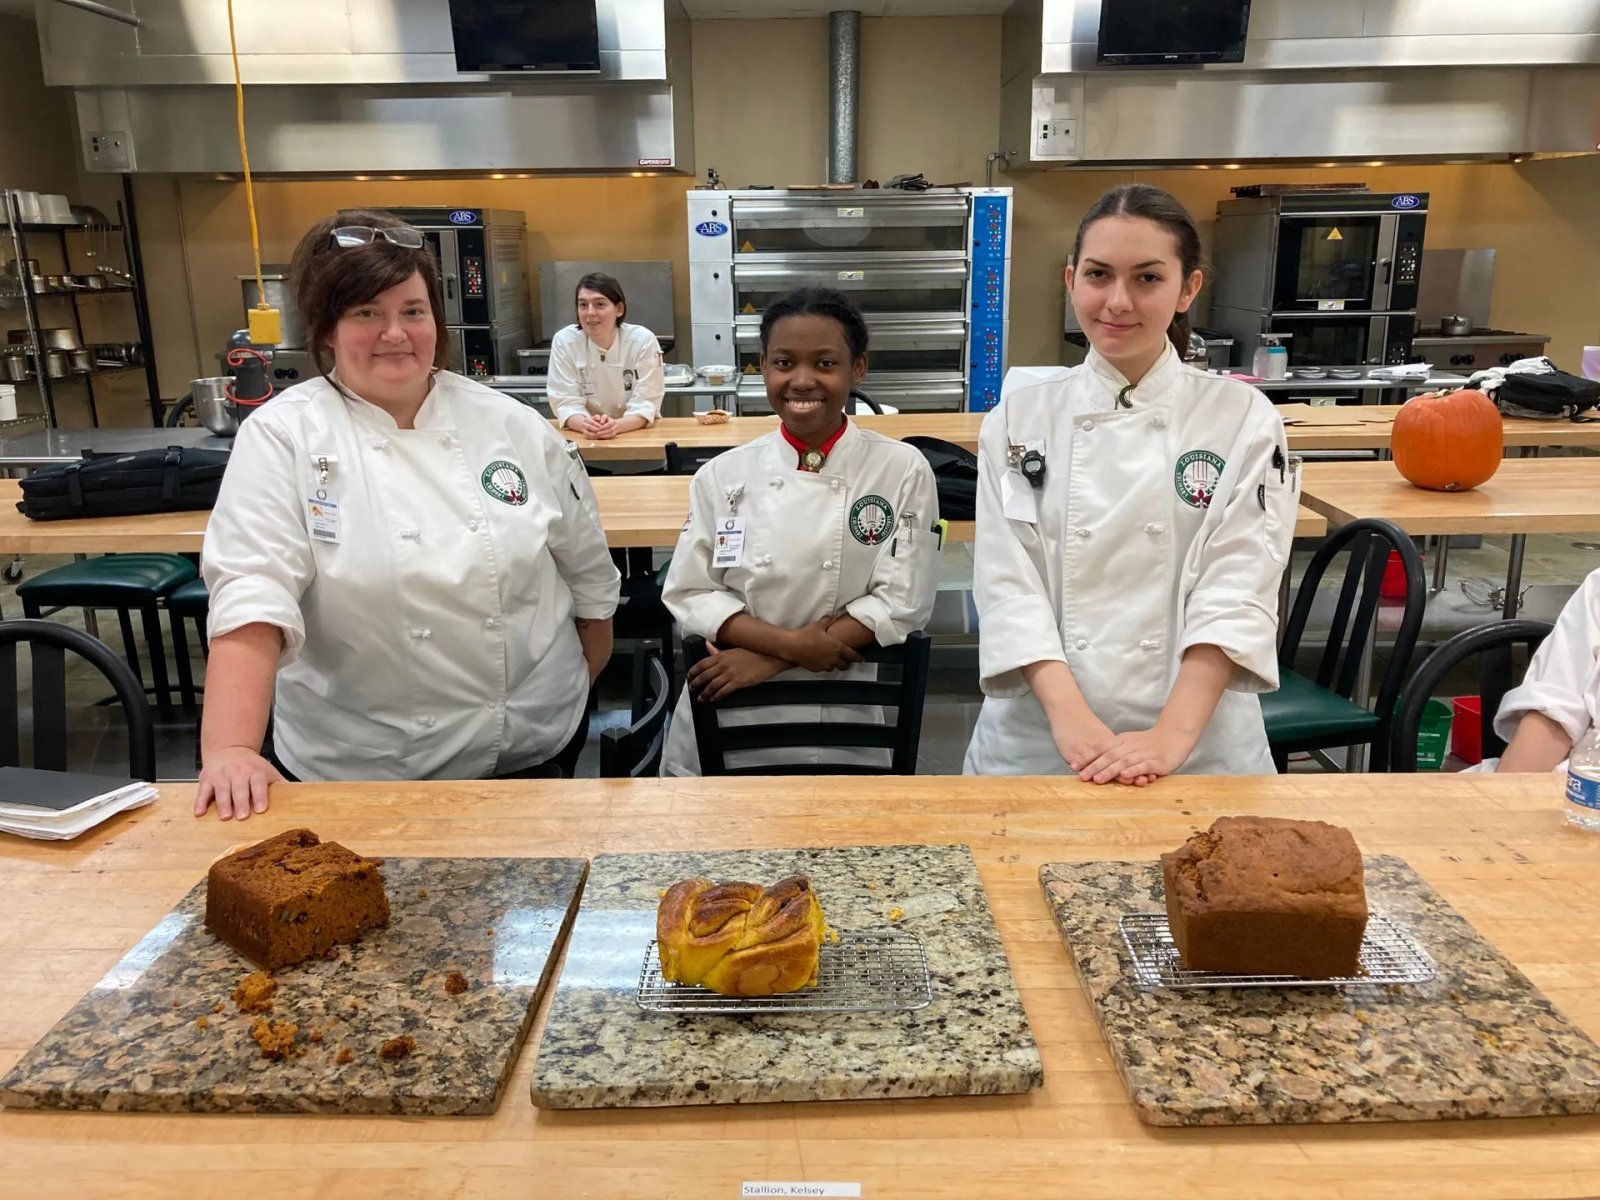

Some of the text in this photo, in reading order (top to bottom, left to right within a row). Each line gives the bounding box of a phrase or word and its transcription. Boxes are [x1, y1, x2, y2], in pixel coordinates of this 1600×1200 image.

[1396, 196, 1414, 206] ABS
[453, 212, 471, 221] ABS
[699, 223, 722, 233] ABS
[1181, 454, 1221, 469] LOUISIANA
[744, 1185, 825, 1195] Stallion, Kelsey
